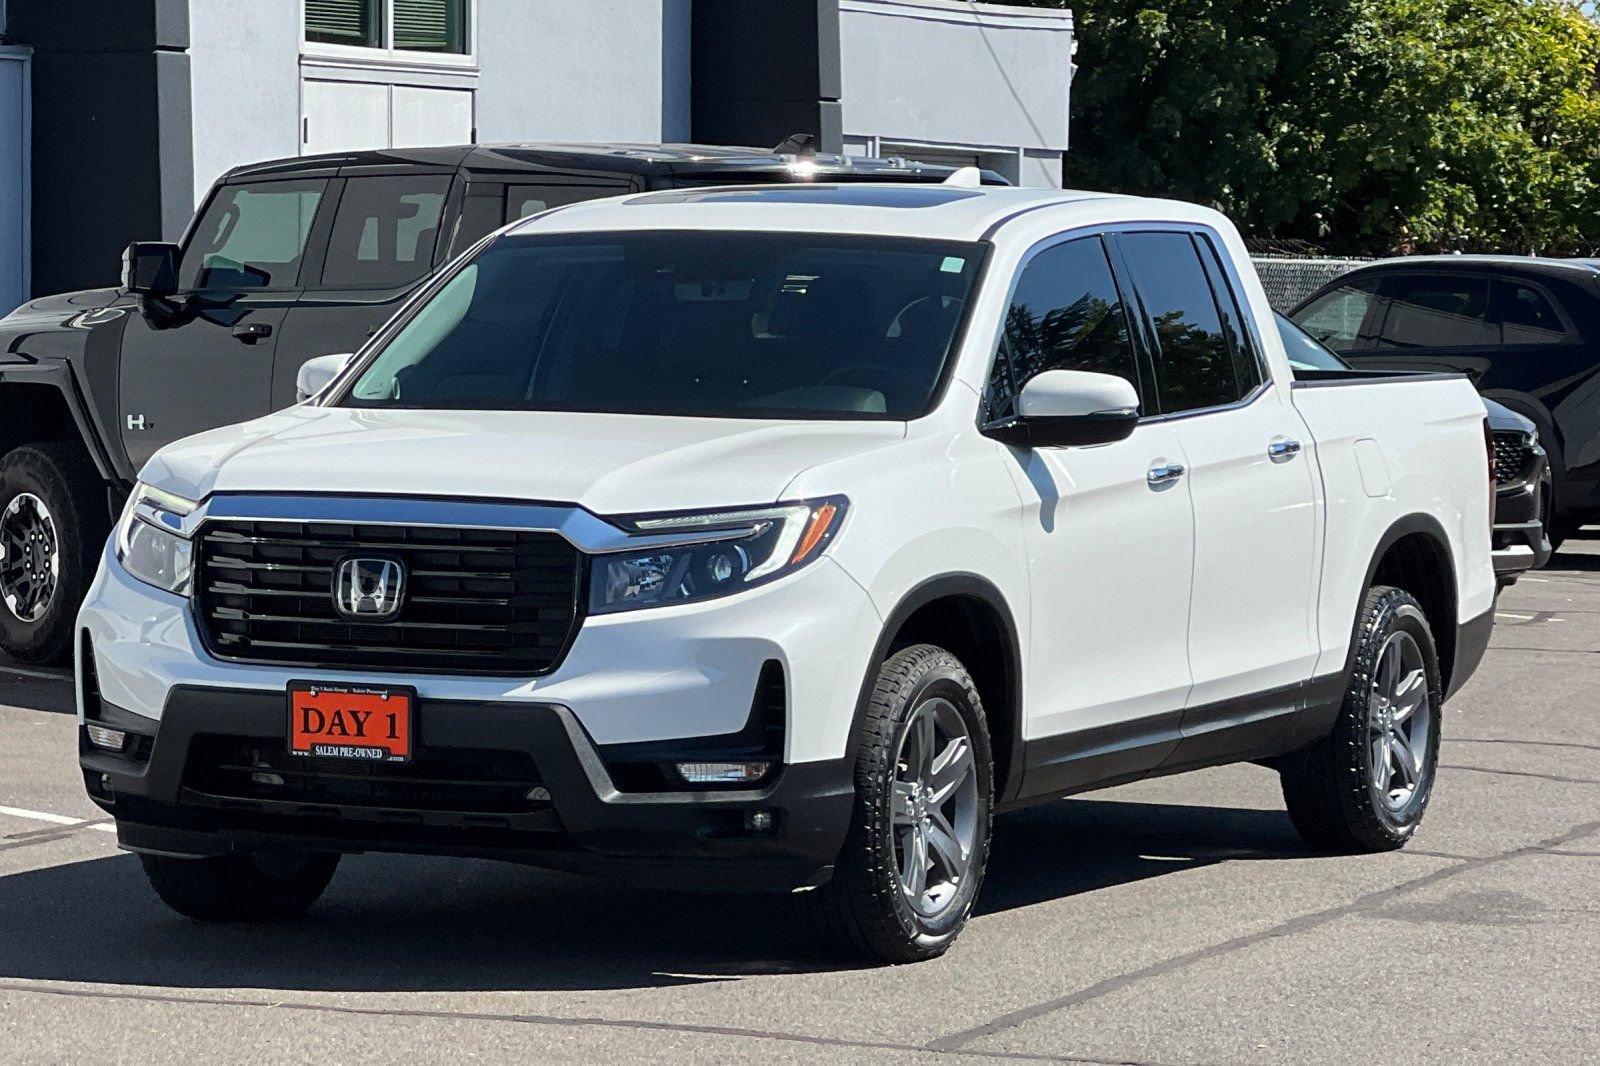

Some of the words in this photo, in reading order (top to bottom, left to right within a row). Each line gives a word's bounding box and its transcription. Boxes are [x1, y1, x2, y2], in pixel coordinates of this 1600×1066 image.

[301, 707, 373, 737] DAY
[386, 713, 400, 738] 1
[315, 745, 338, 756] SALEM
[340, 747, 382, 758] PRE-OWNED
